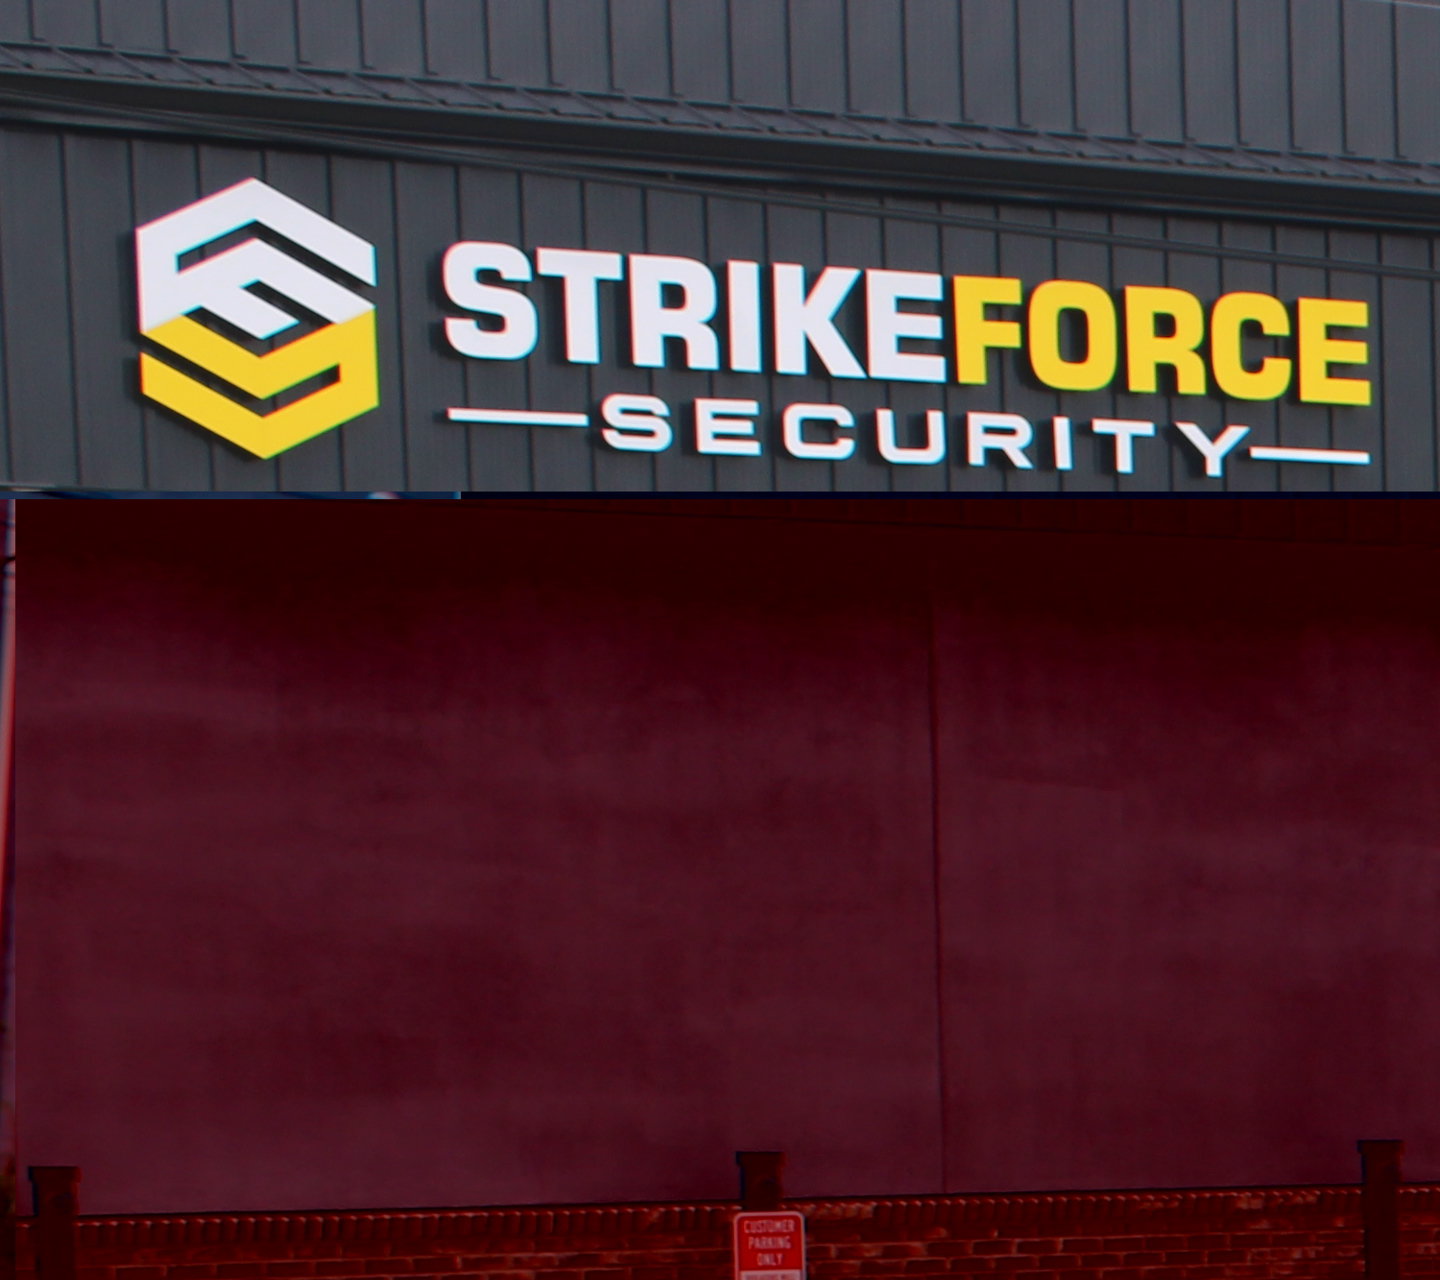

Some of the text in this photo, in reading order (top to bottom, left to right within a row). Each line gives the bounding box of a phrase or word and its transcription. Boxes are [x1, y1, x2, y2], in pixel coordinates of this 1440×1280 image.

[442, 240, 1372, 406] STRIKEFORCE
[600, 393, 1250, 478] SECURITY
[744, 1219, 796, 1233] CUSTOMER
[748, 1235, 792, 1249] PARKING
[757, 1252, 783, 1266] ONLY
